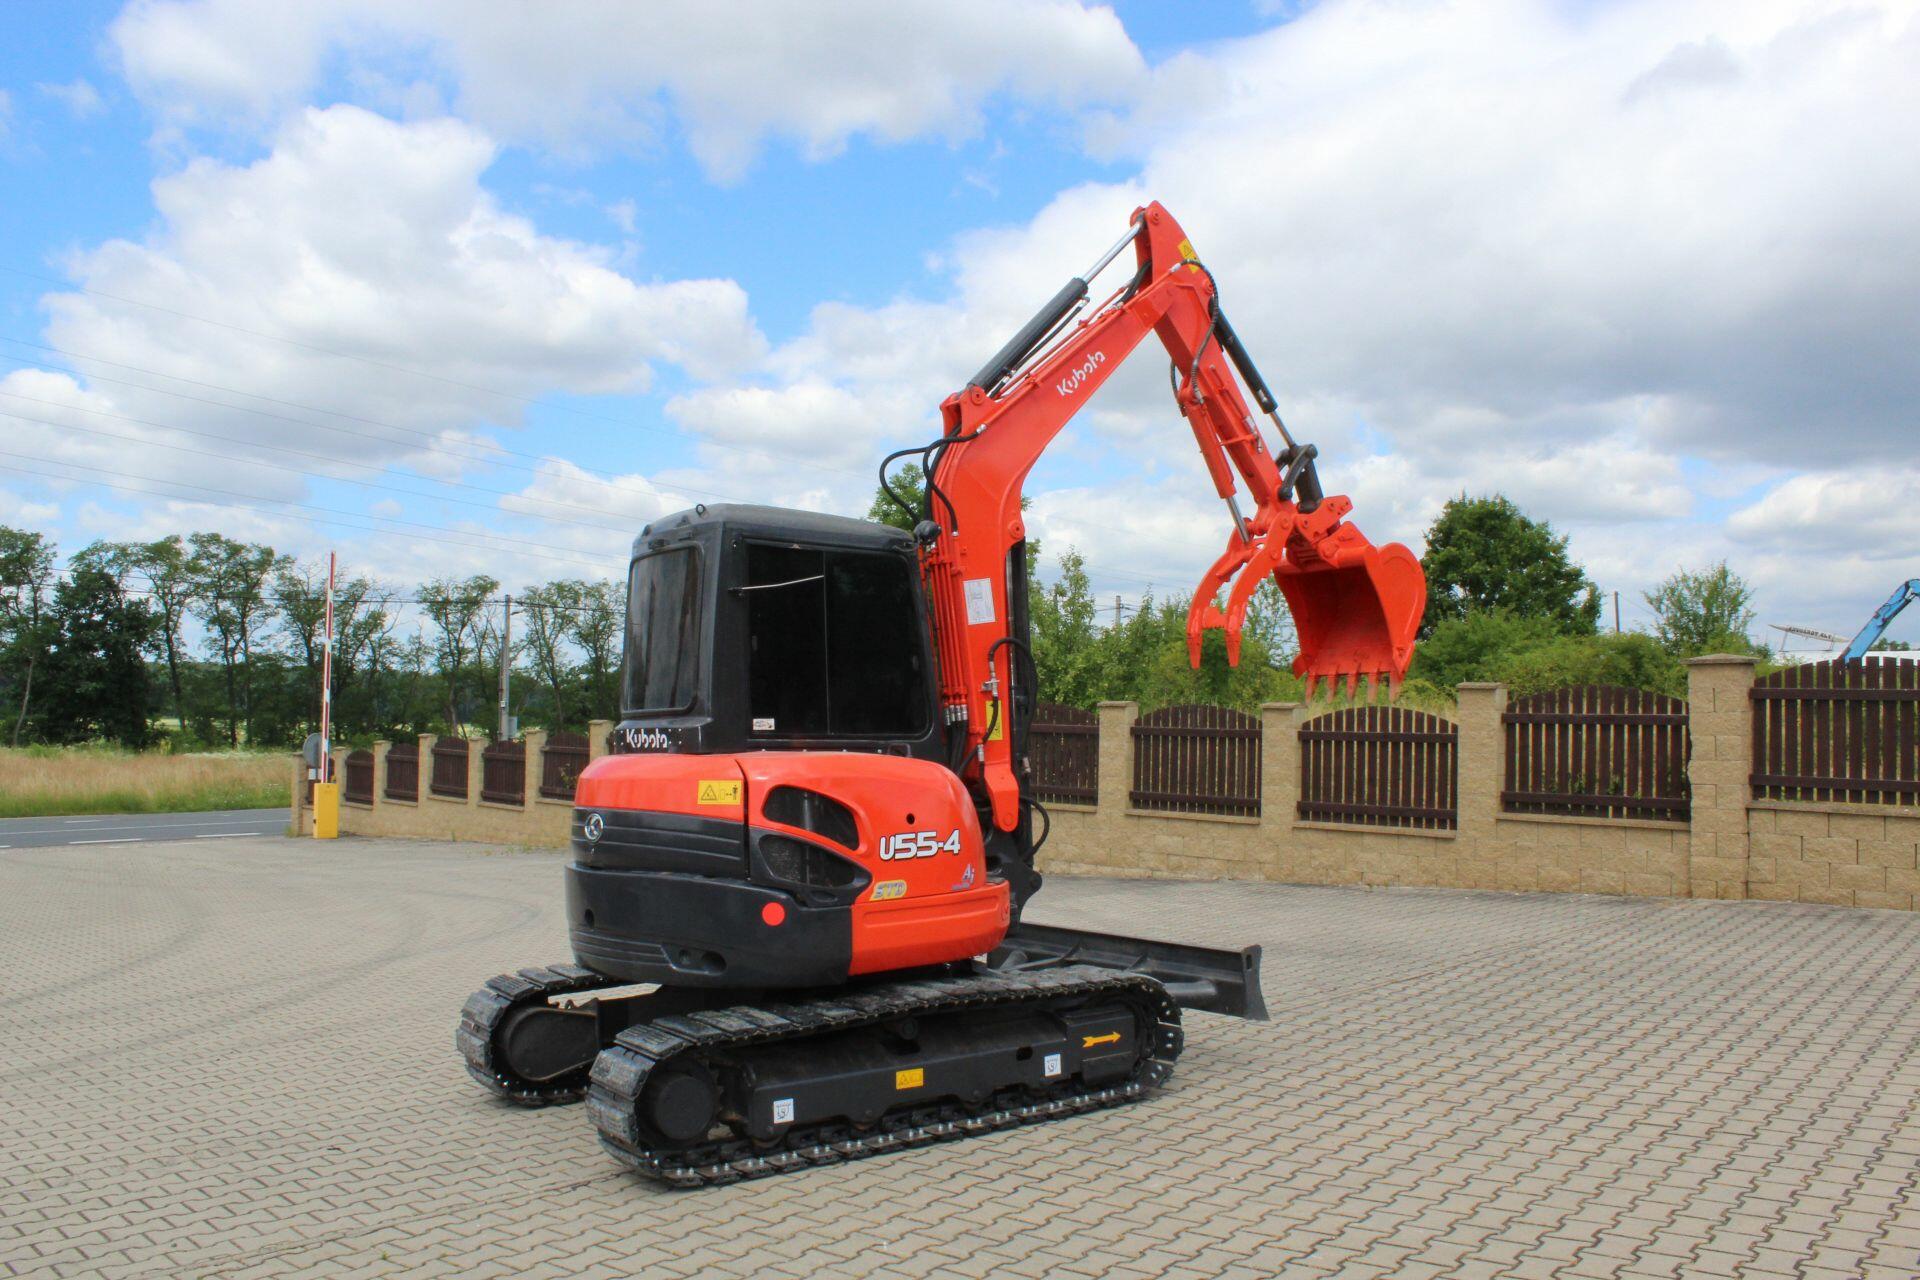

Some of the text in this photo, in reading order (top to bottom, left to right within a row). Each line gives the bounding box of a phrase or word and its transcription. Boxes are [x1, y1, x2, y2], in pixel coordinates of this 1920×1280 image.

[1056, 351, 1106, 396] Kubota
[626, 728, 668, 749] Kubota
[880, 829, 961, 861] U55-4
